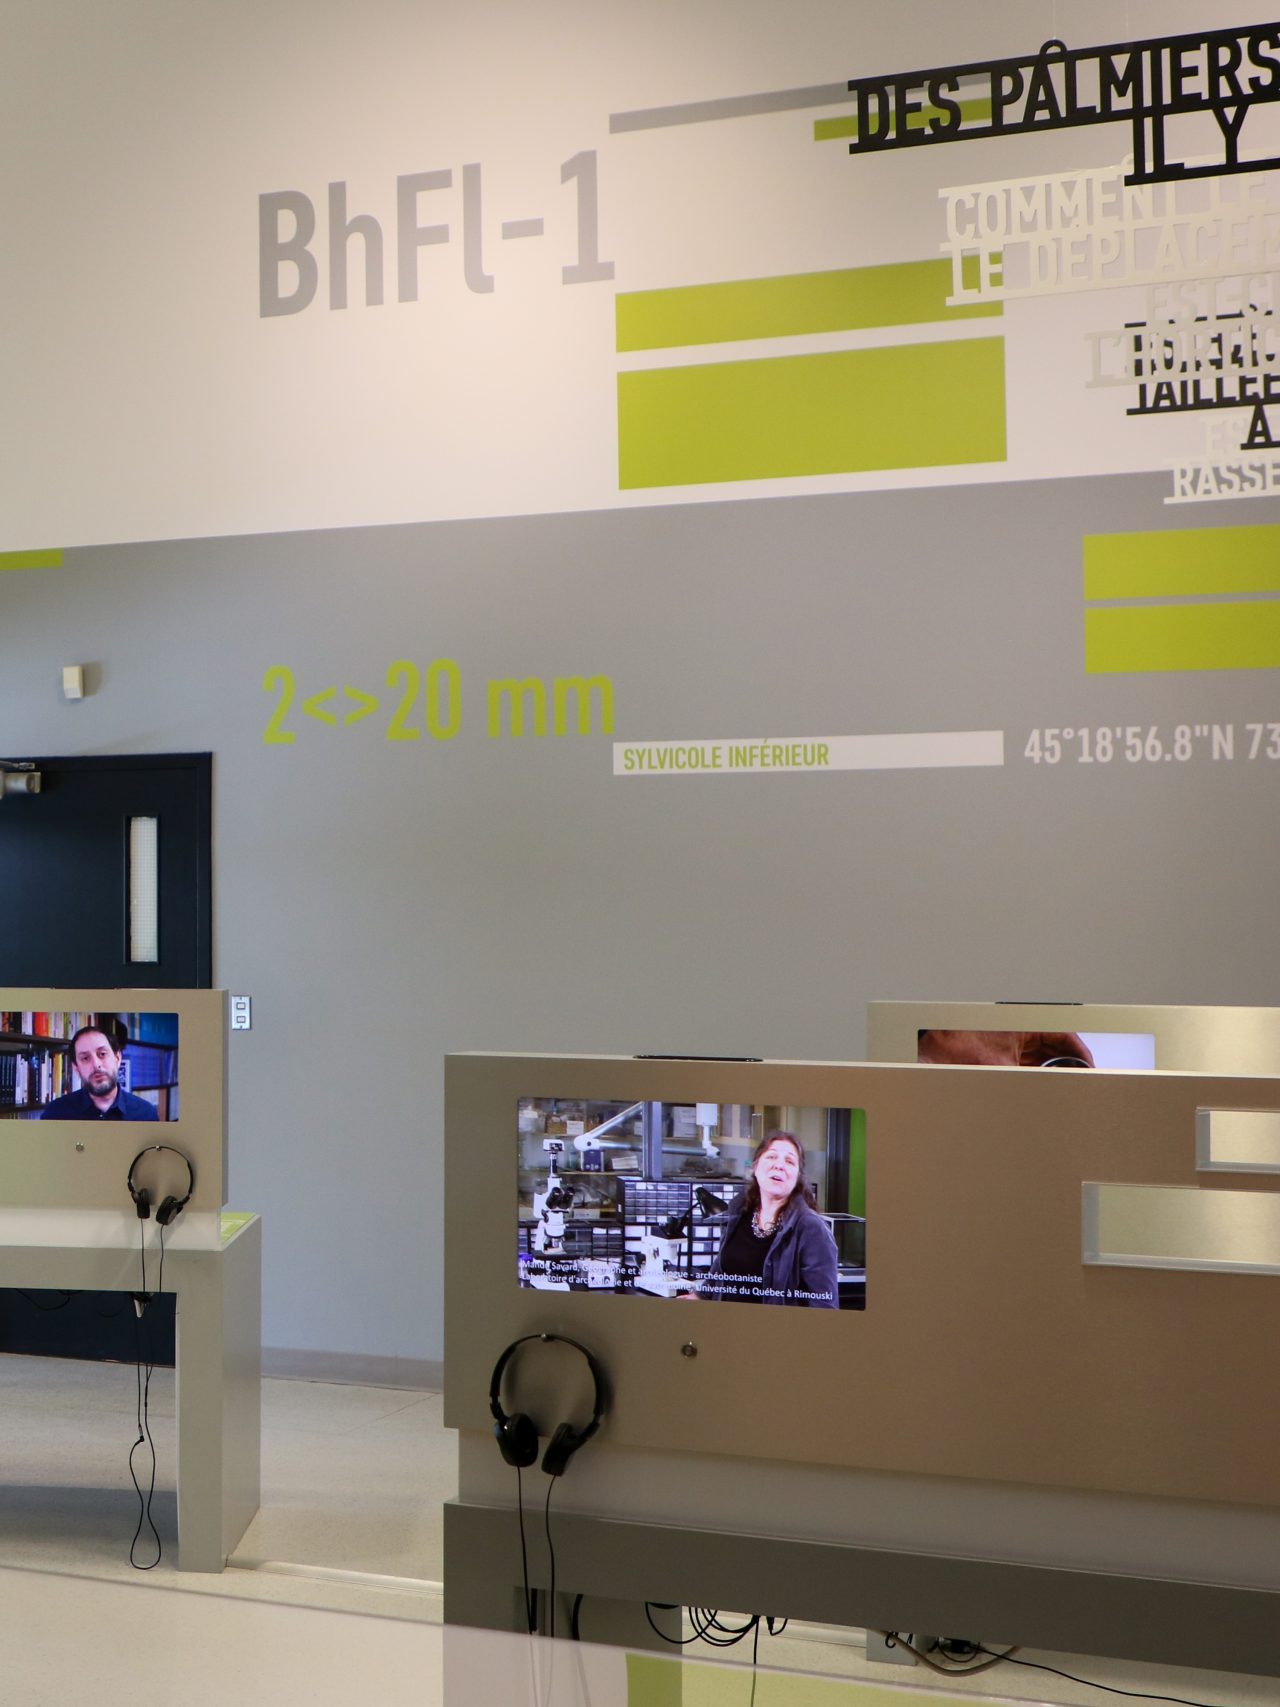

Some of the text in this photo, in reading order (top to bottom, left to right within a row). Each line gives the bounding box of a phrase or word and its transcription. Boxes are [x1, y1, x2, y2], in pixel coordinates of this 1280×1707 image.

[856, 74, 961, 144] DES
[1133, 102, 1250, 176] IL Y
[258, 149, 615, 318] BhFl-1
[952, 245, 1005, 297] LE
[486, 673, 614, 739] mm
[623, 737, 830, 770] SYLVICOLE INFÉRIEUR
[695, 1271, 763, 1284] archéobotaniste
[695, 1282, 738, 1295] Université
[738, 1284, 751, 1295] du
[752, 1286, 785, 1298] Québec
[794, 1290, 833, 1301] Rimouski
